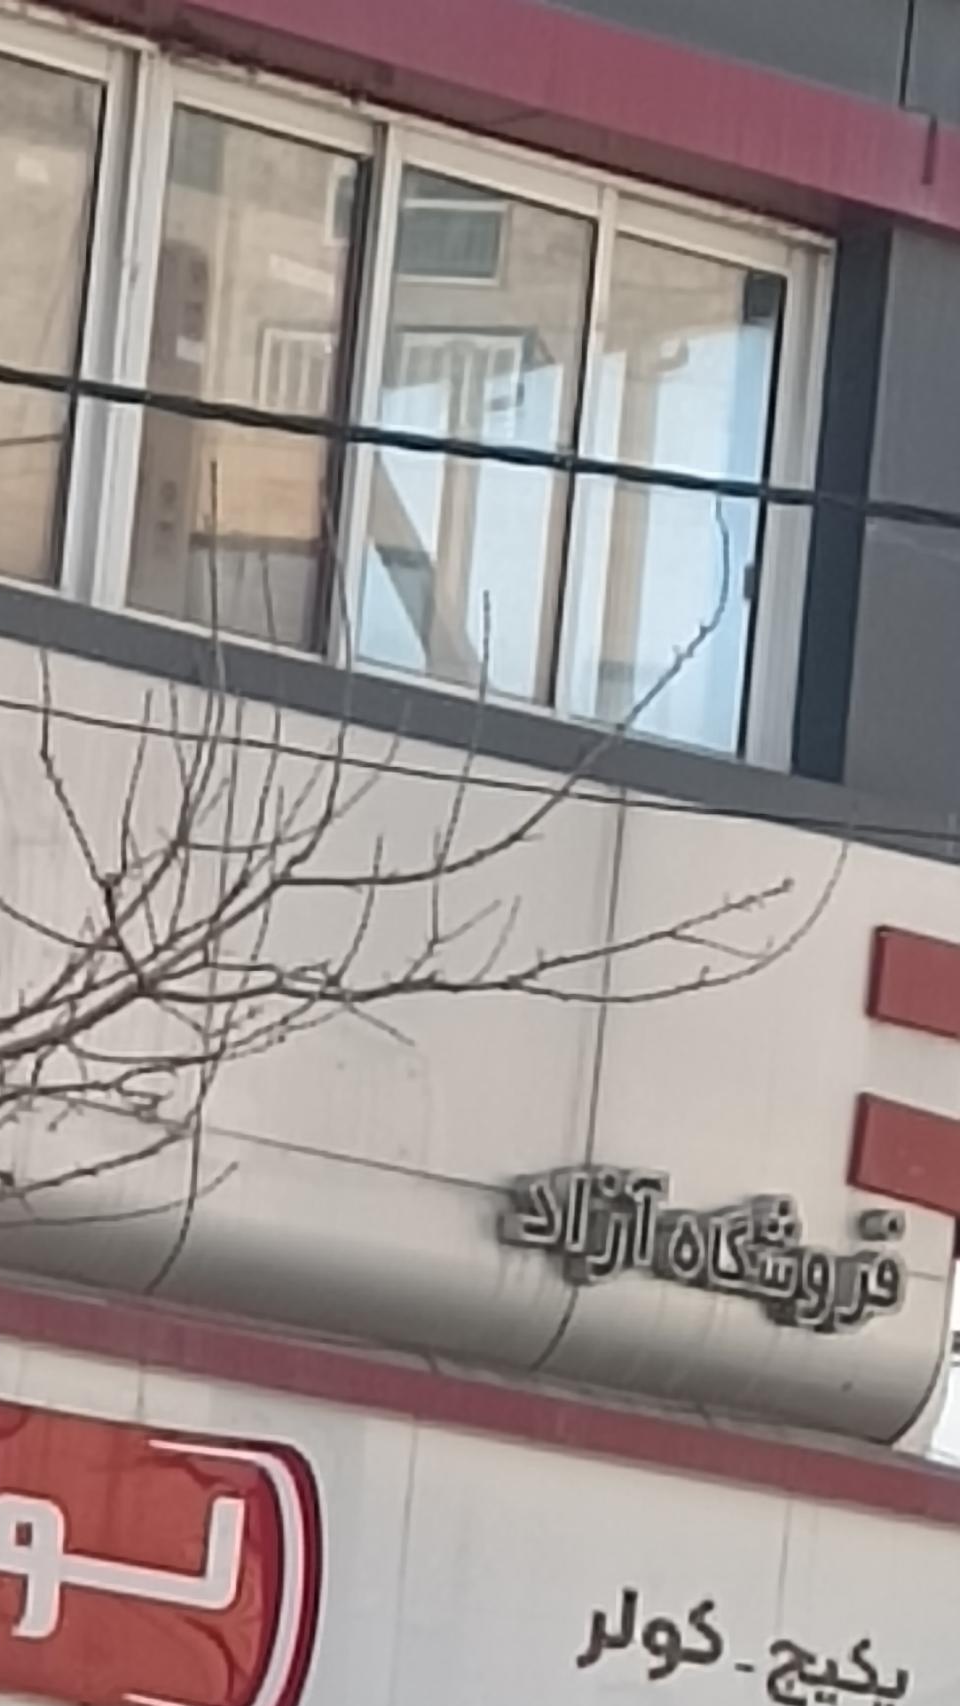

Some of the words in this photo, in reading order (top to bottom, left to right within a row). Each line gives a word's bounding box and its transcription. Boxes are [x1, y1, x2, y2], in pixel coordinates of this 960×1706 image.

[512, 1168, 668, 1283] آزاد
[662, 1196, 904, 1332] فروشگاه
[576, 1587, 724, 1681] کولر
